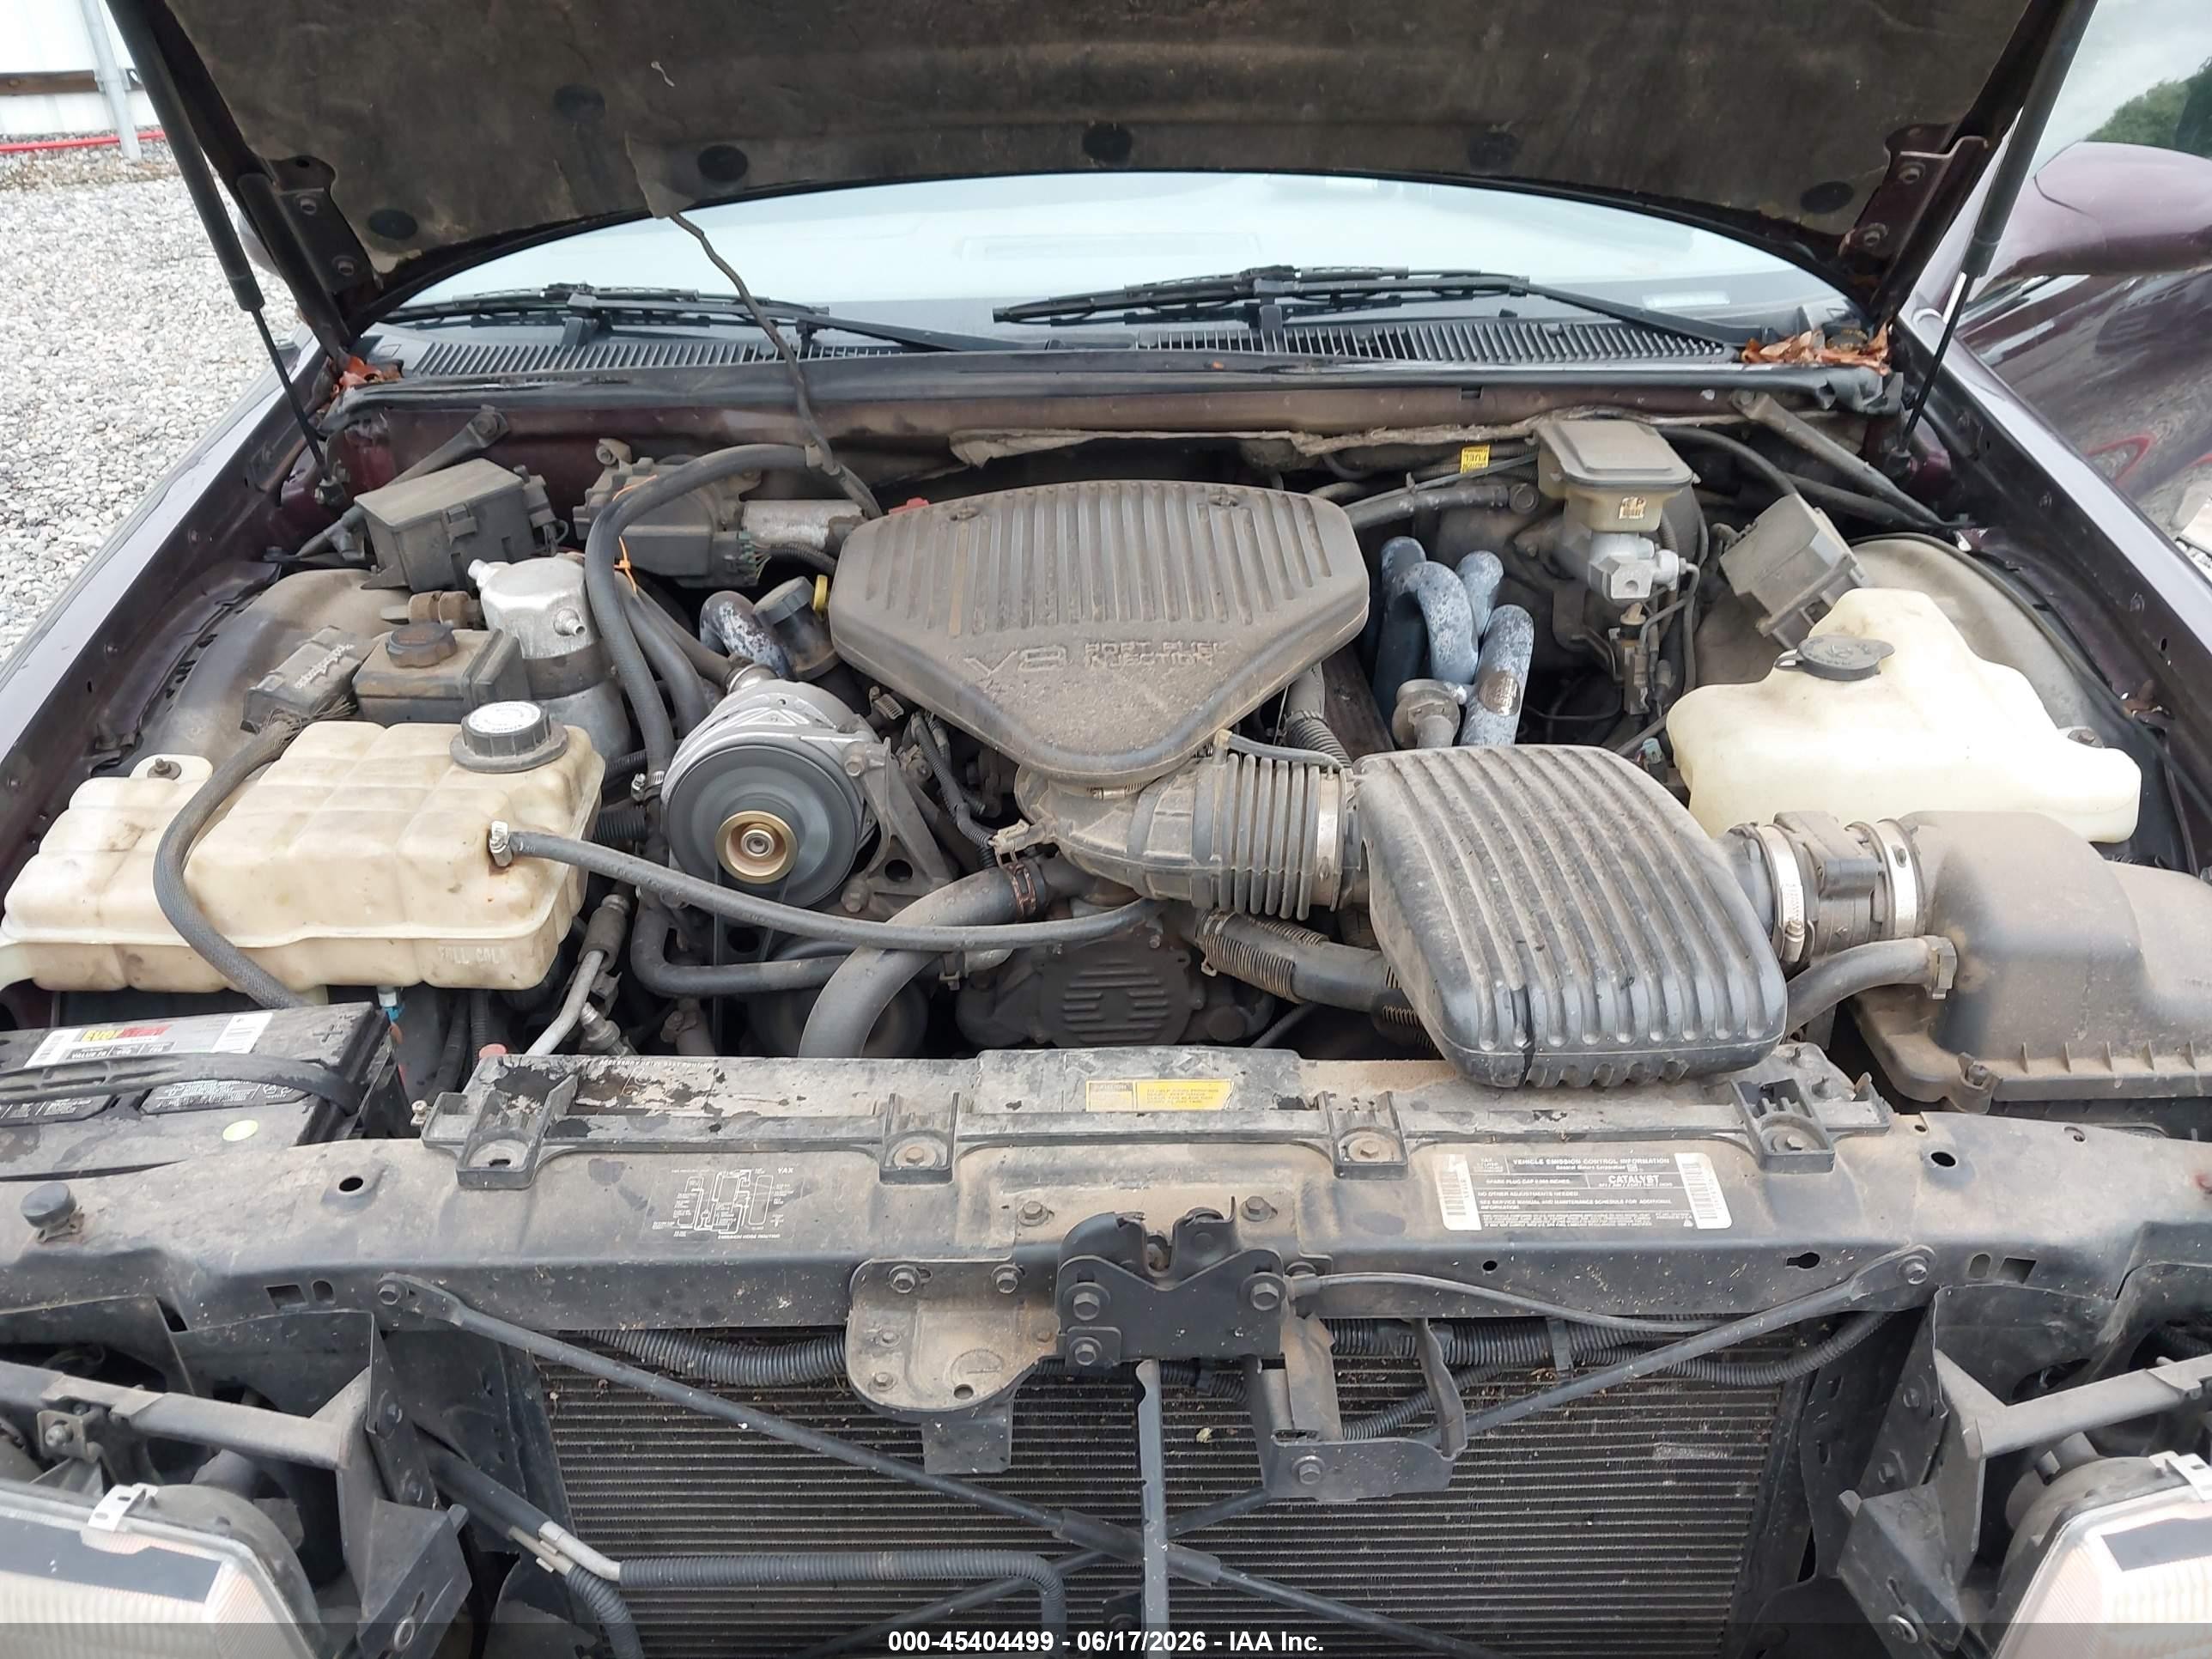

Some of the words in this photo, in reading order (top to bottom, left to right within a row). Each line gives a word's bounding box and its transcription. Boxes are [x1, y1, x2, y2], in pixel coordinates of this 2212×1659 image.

[1085, 641, 1152, 656] PORT
[1163, 641, 1226, 656] FUEL
[963, 646, 1067, 677] V8
[1085, 653, 1213, 668] INJECTION
[1607, 1175, 1660, 1184] CATALYST
